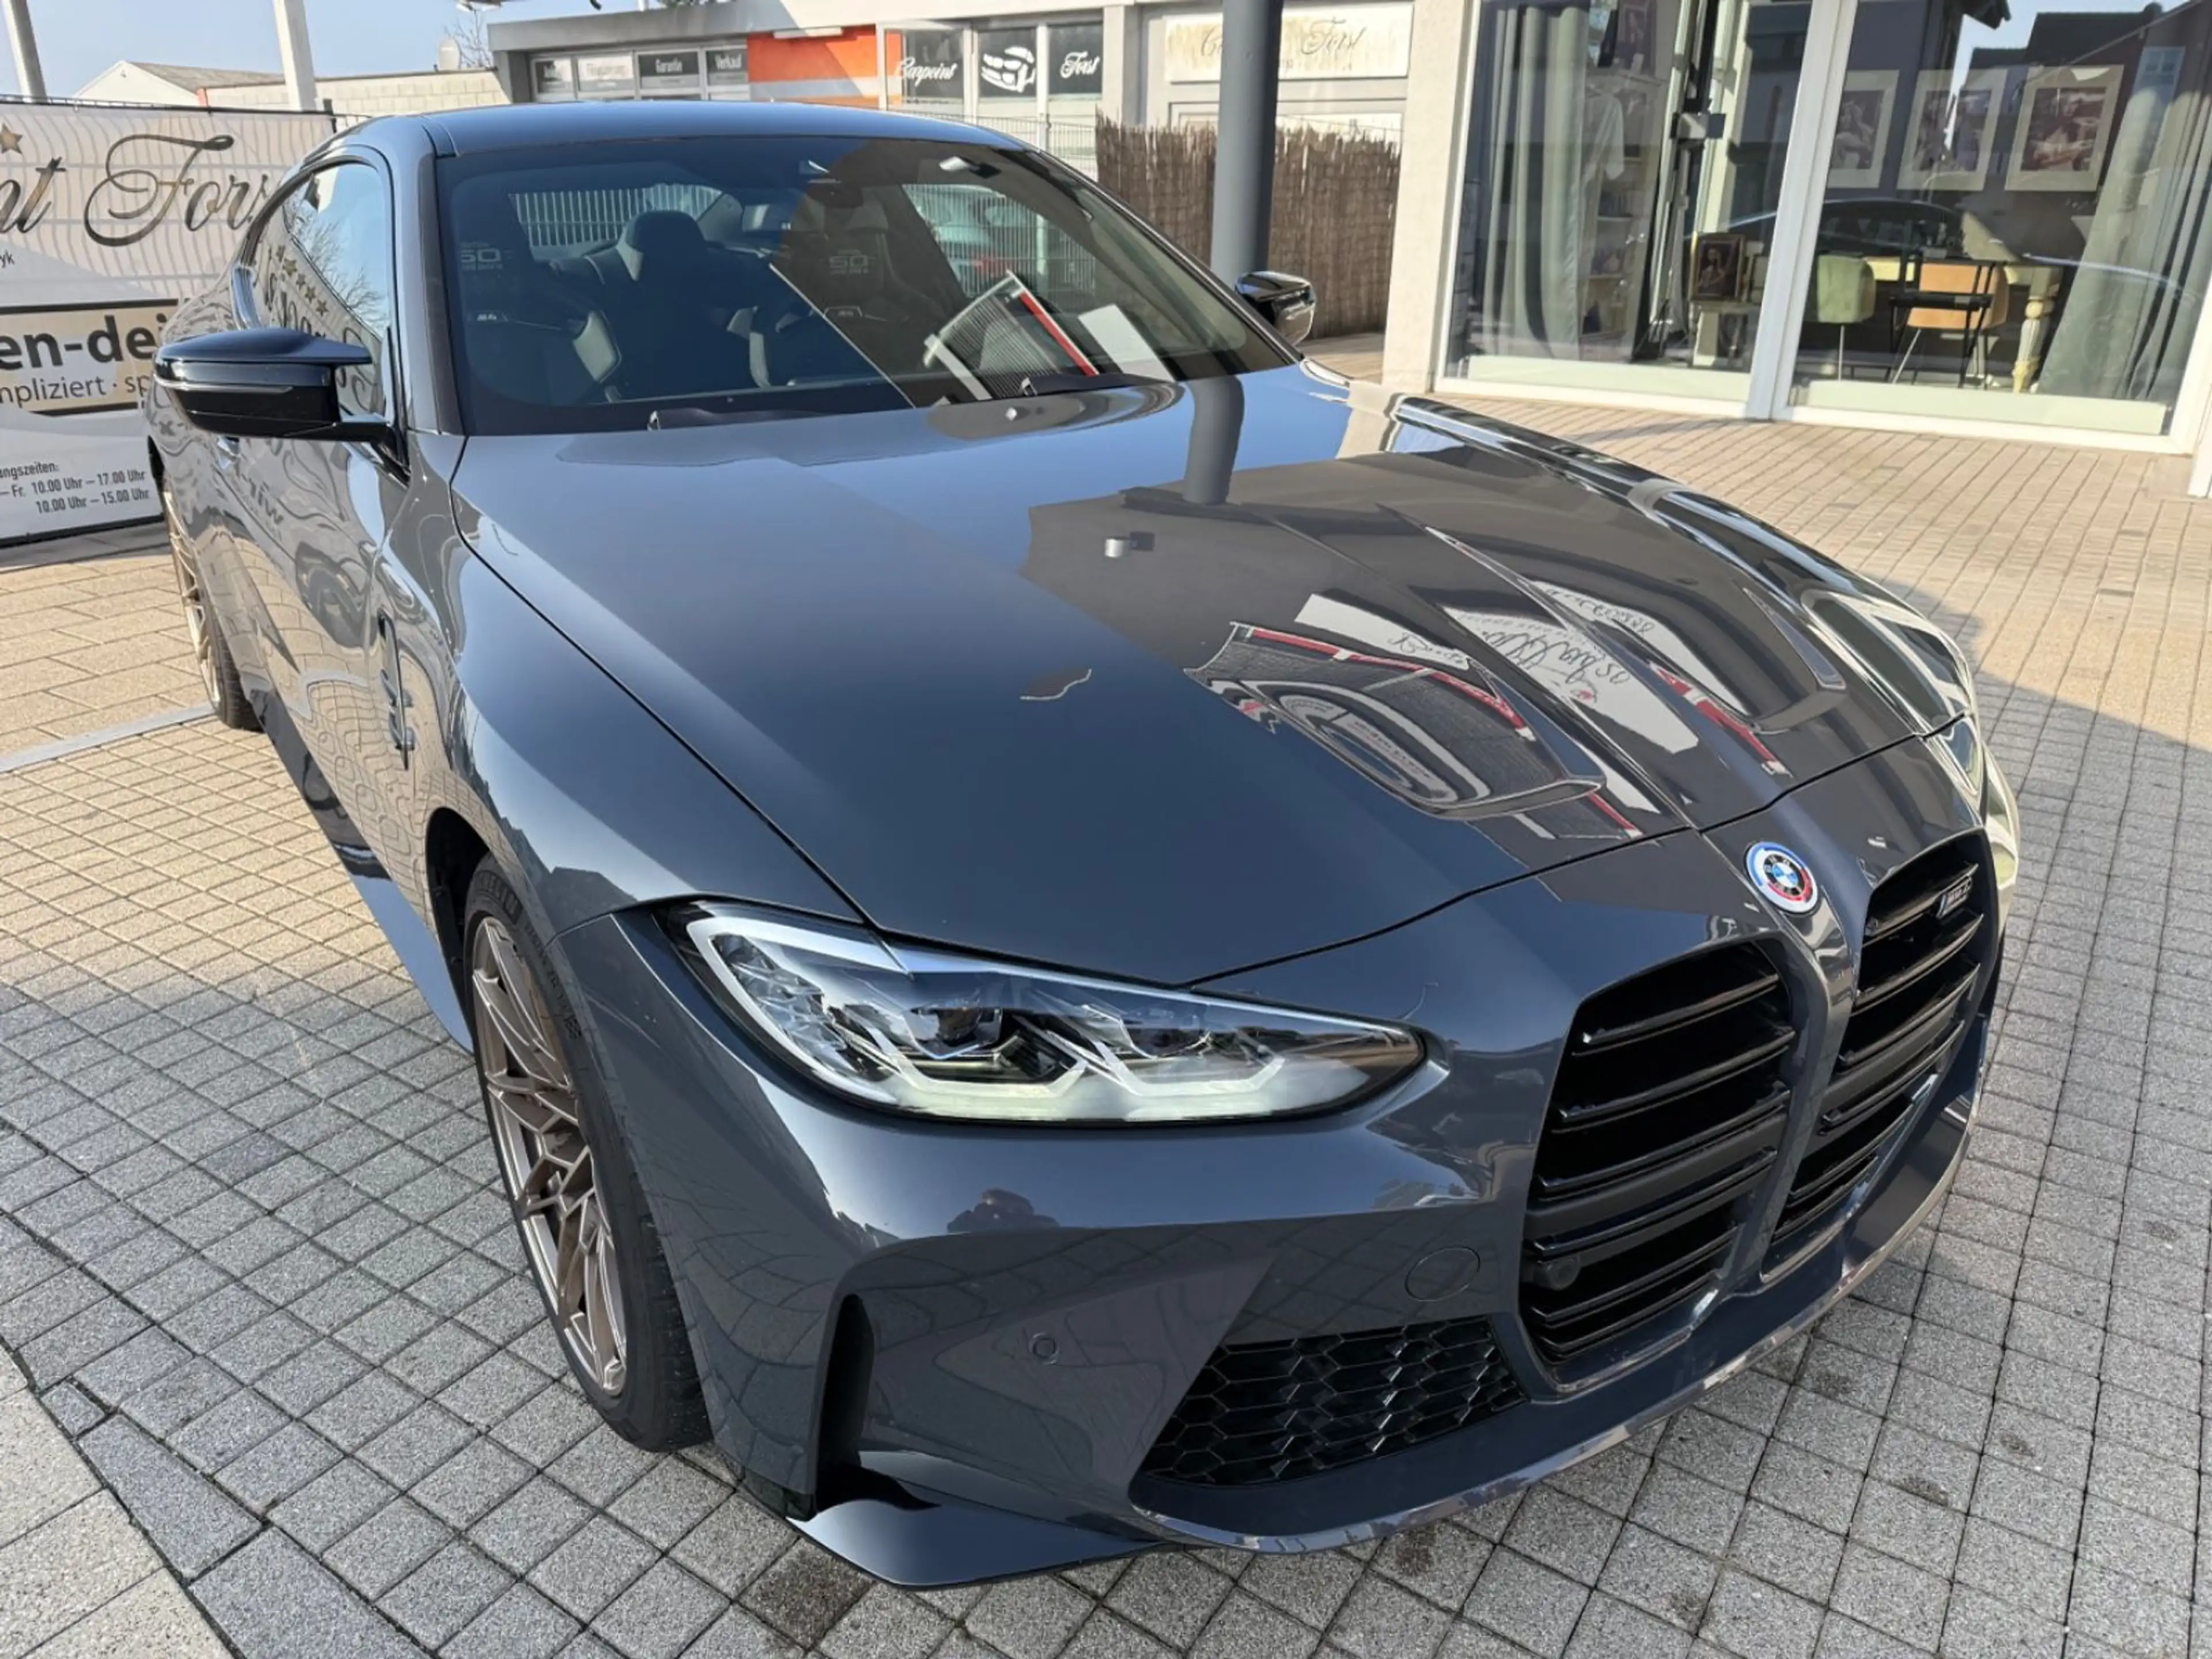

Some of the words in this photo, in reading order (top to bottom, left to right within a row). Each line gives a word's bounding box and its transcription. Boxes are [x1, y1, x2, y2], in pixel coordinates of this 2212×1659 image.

[63, 477, 82, 490] Uhr
[127, 469, 146, 482] Uhr
[67, 497, 87, 509] Uhr
[131, 487, 150, 501] Uhr
